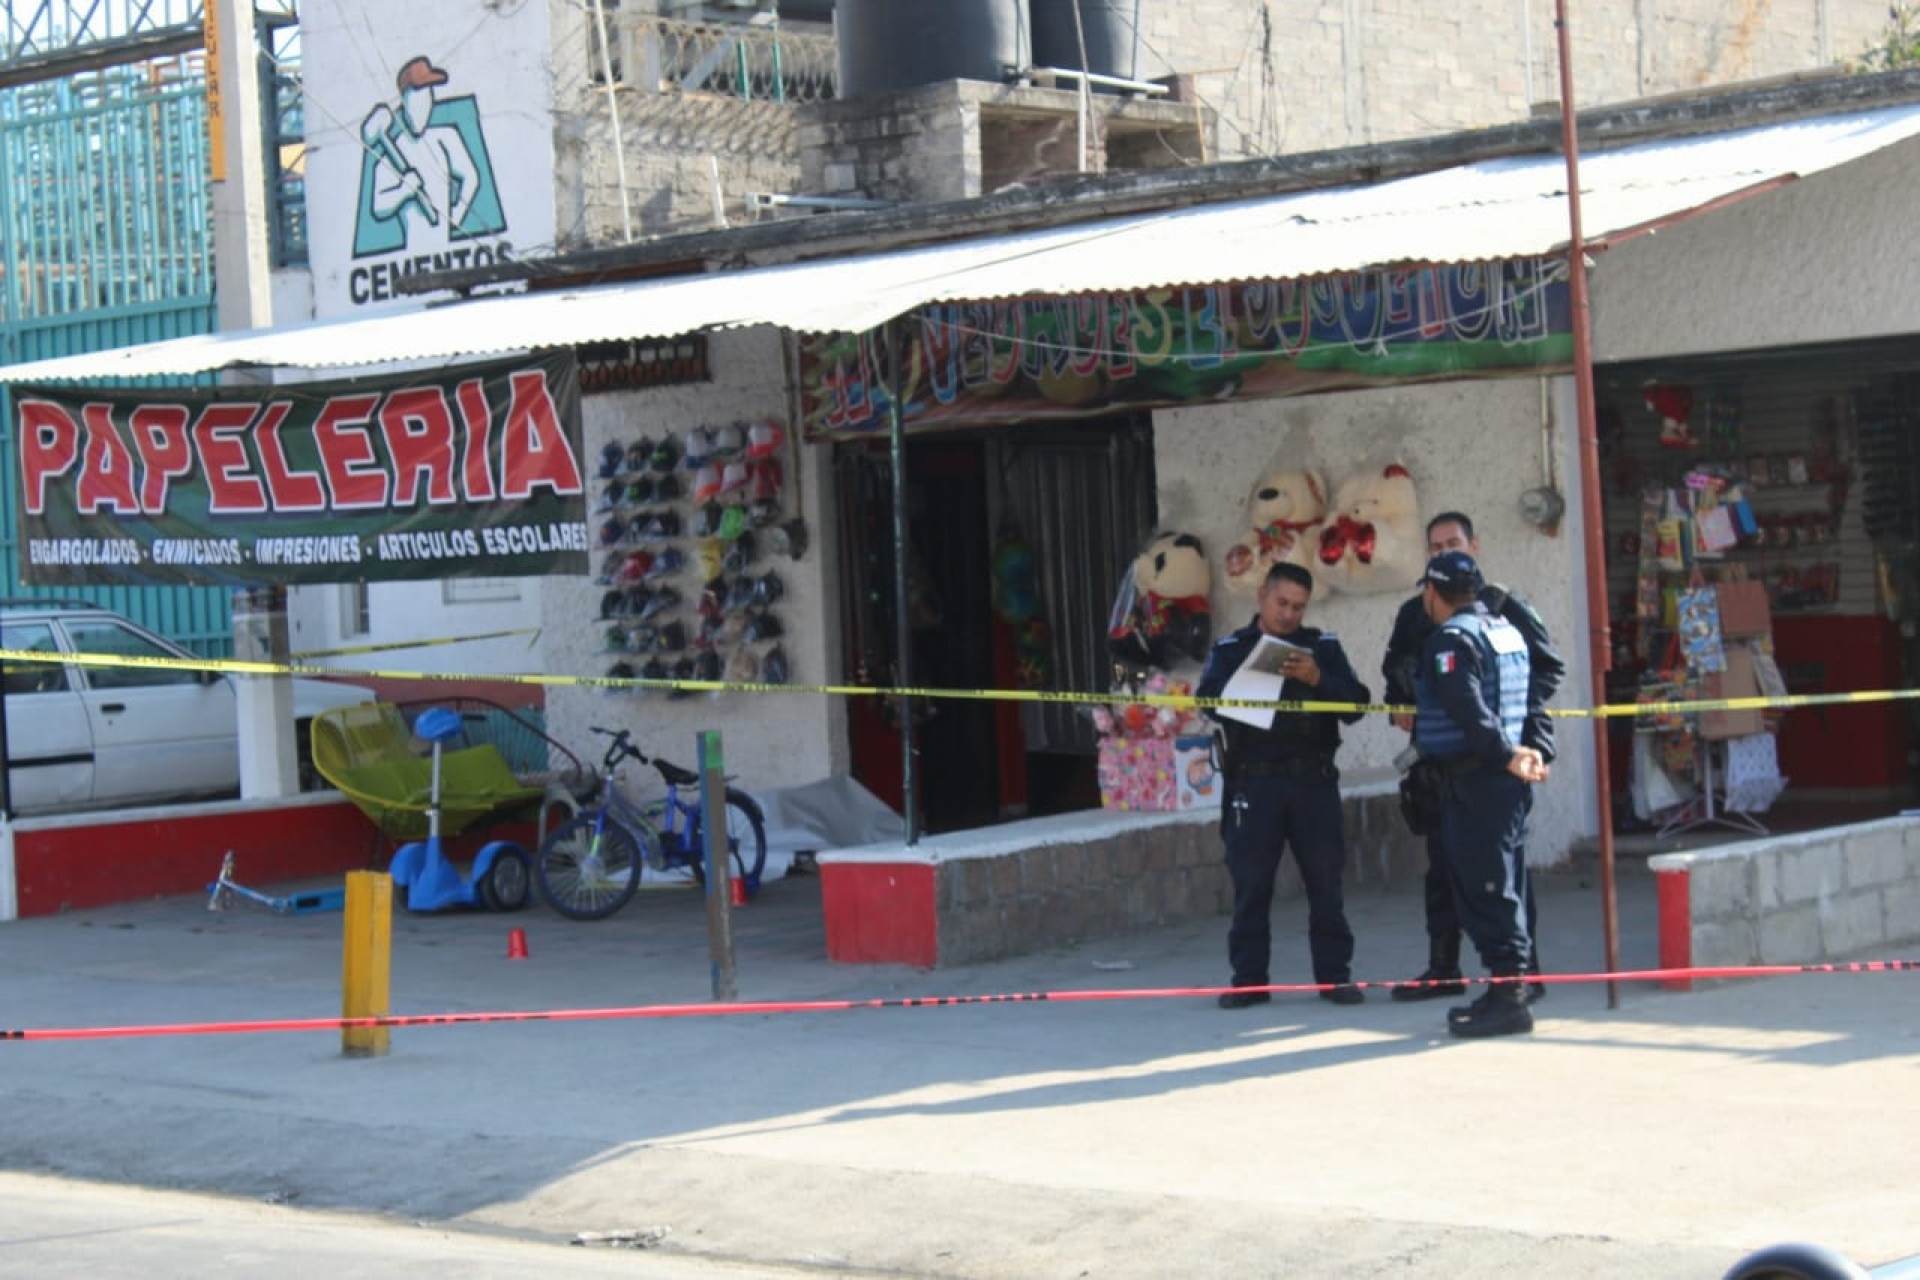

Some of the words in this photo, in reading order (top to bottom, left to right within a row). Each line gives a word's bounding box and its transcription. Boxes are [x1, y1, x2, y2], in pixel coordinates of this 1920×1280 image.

[206, 0, 220, 117] ICULAR
[18, 369, 582, 514] PAPELERIA
[152, 538, 242, 564] ENMICADOS
[255, 534, 361, 564] IMPRESIONES
[378, 528, 479, 561] ARTICULOS
[482, 521, 587, 555] ESCOLARES
